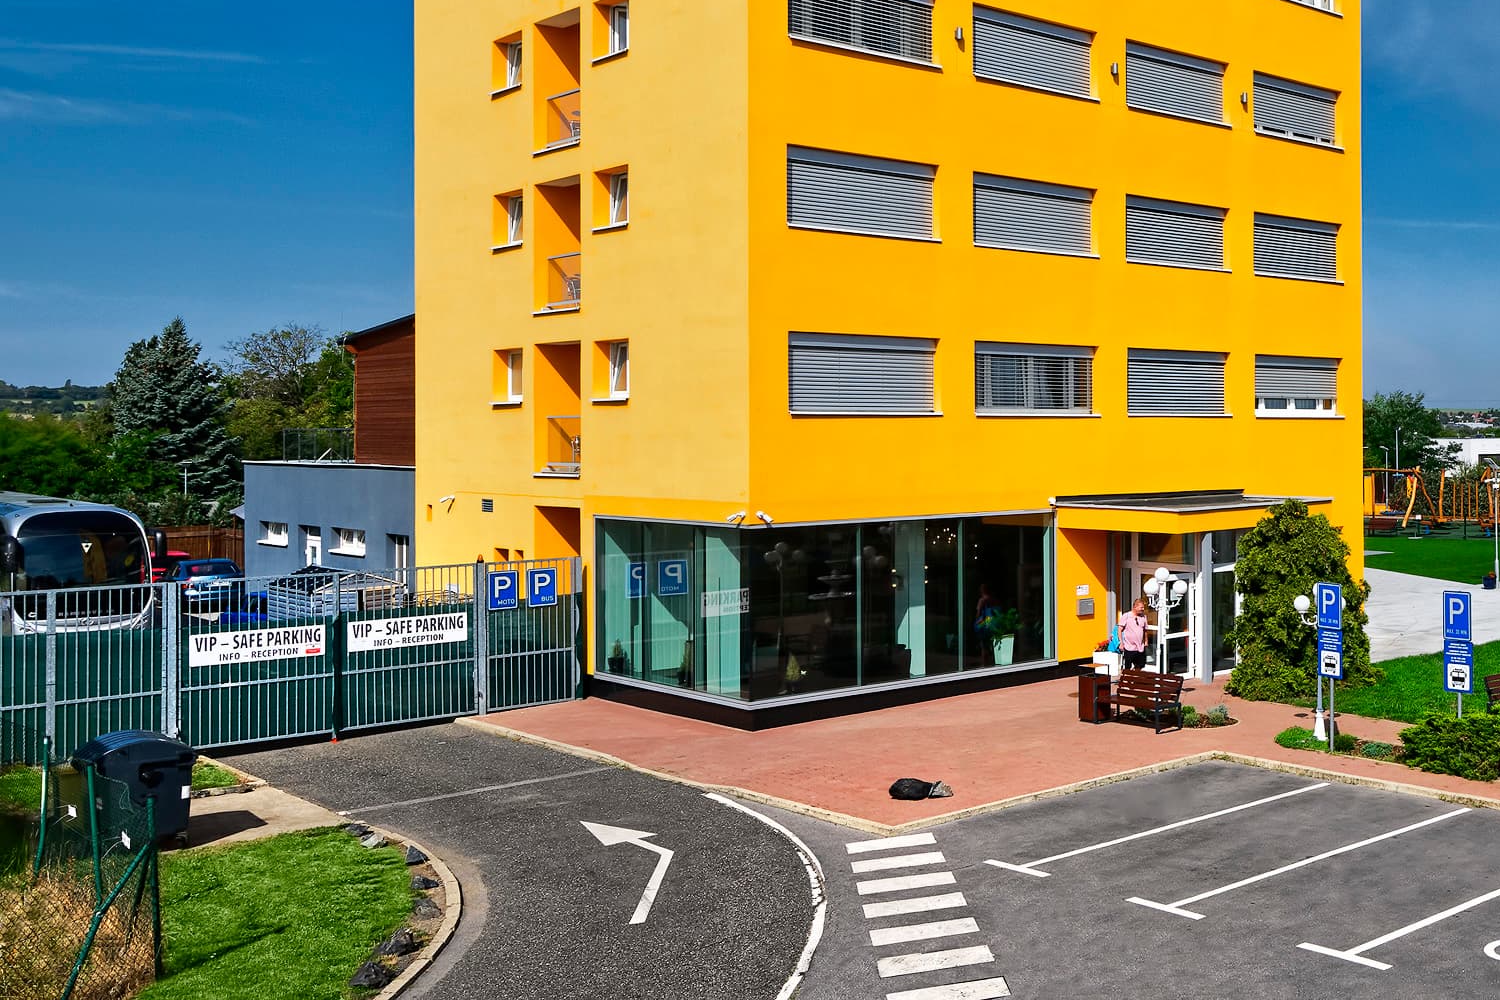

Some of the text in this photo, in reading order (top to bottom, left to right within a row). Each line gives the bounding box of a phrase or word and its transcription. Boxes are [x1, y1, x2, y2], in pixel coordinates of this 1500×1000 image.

[494, 575, 511, 598] P
[534, 573, 551, 595] P
[1322, 588, 1336, 614] P
[1449, 597, 1465, 625] P
[352, 623, 372, 639] VIP
[386, 620, 412, 636] SAFE
[415, 615, 464, 633] PARKING
[194, 636, 217, 653] VIP
[232, 632, 263, 650] SAFE
[266, 628, 321, 647] PARKING
[373, 638, 393, 647] INFO
[402, 634, 444, 644] RECEPTION
[219, 652, 241, 662] INFO
[251, 648, 299, 659] RECEPTION
